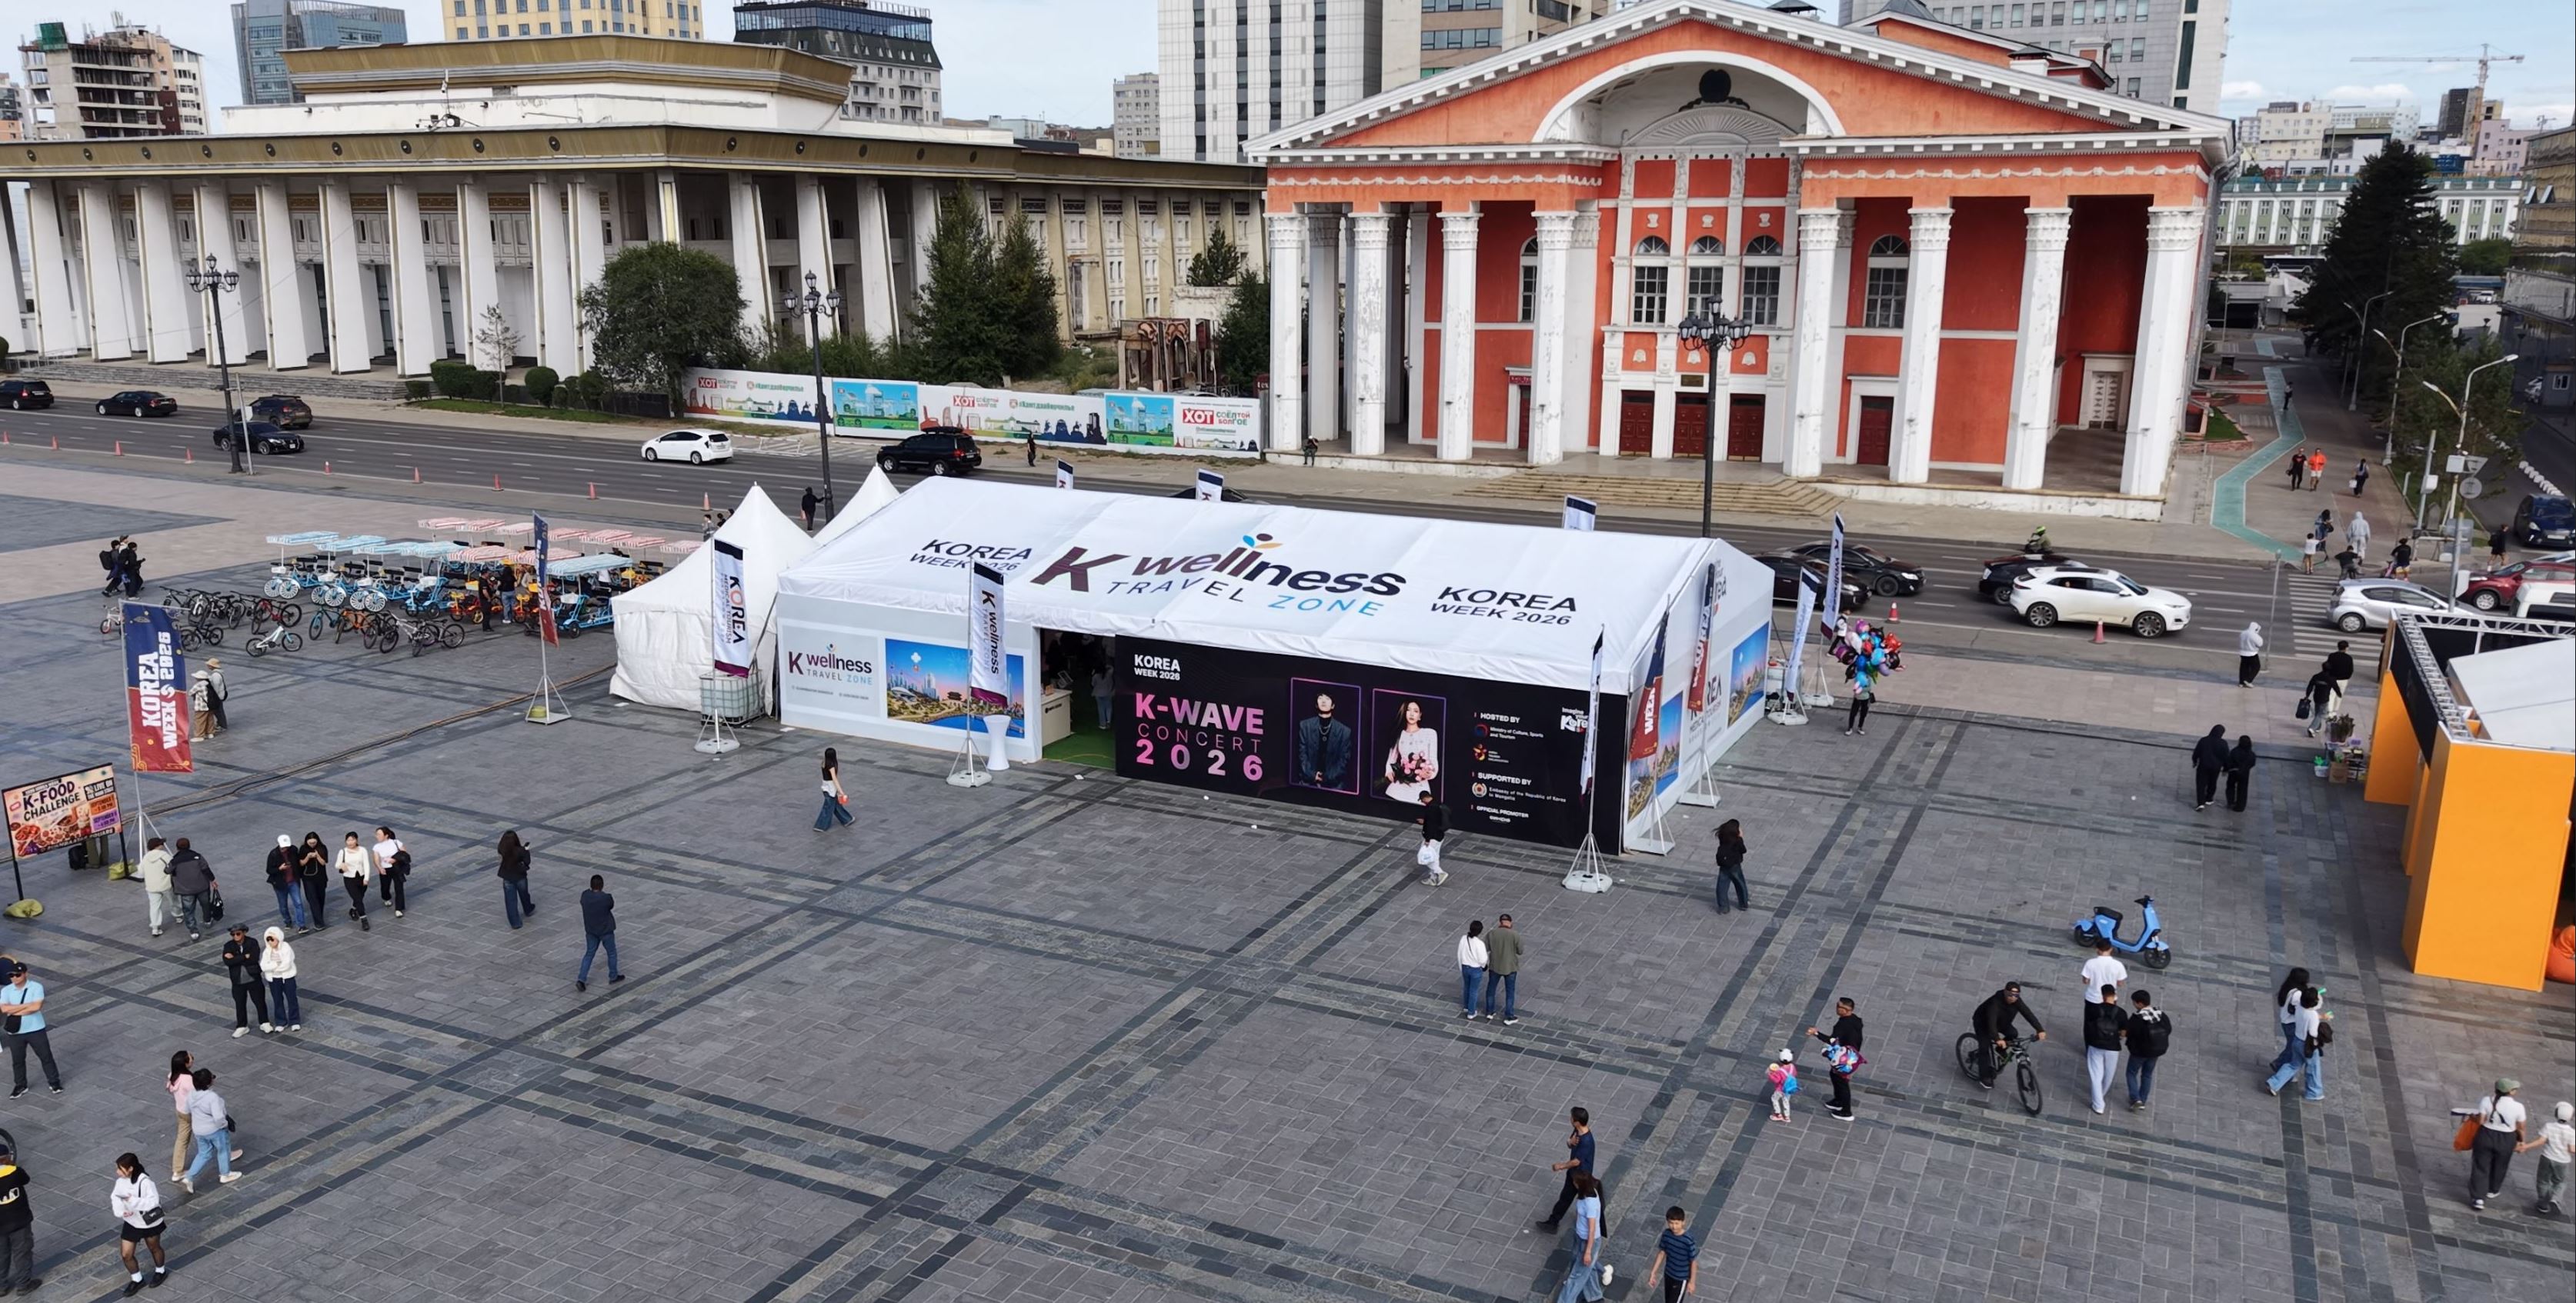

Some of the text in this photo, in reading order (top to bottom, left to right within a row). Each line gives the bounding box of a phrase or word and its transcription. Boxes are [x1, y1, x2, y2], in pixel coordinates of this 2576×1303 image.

[699, 378, 716, 388] ХОТ
[954, 397, 975, 407] ХОТ
[1183, 411, 1213, 425] ХОТ
[921, 539, 1032, 560] KOREA
[909, 553, 967, 569] WEEK
[1030, 546, 1406, 596] K wellness
[1106, 578, 1384, 617] TRAVEL ZONE
[1438, 586, 1577, 612] KOREA
[729, 576, 746, 644] KOREA
[1430, 602, 1572, 625] WEEK 2026
[982, 590, 999, 675] K wellness
[788, 652, 872, 675] K wellness
[1134, 654, 1180, 671] KOREA
[807, 669, 873, 685] TRAVEL ZONE
[1134, 667, 1180, 681] WEEK 2026
[138, 652, 162, 727] KOREA
[1136, 692, 1264, 735] K-WAVE
[1480, 712, 1509, 722] HOSTED
[1562, 707, 1584, 715] Imagine
[162, 701, 178, 750] WEEK
[1560, 715, 1588, 731] Kore
[1138, 723, 1262, 753] CONCERT
[1478, 772, 1520, 785] SUPPORTED
[23, 781, 75, 811] K-FOOD
[1489, 787, 1509, 795] Embassy
[24, 792, 81, 821] CHALLENGE
[1477, 805, 1529, 818] OFFICIAL PROMOTER
